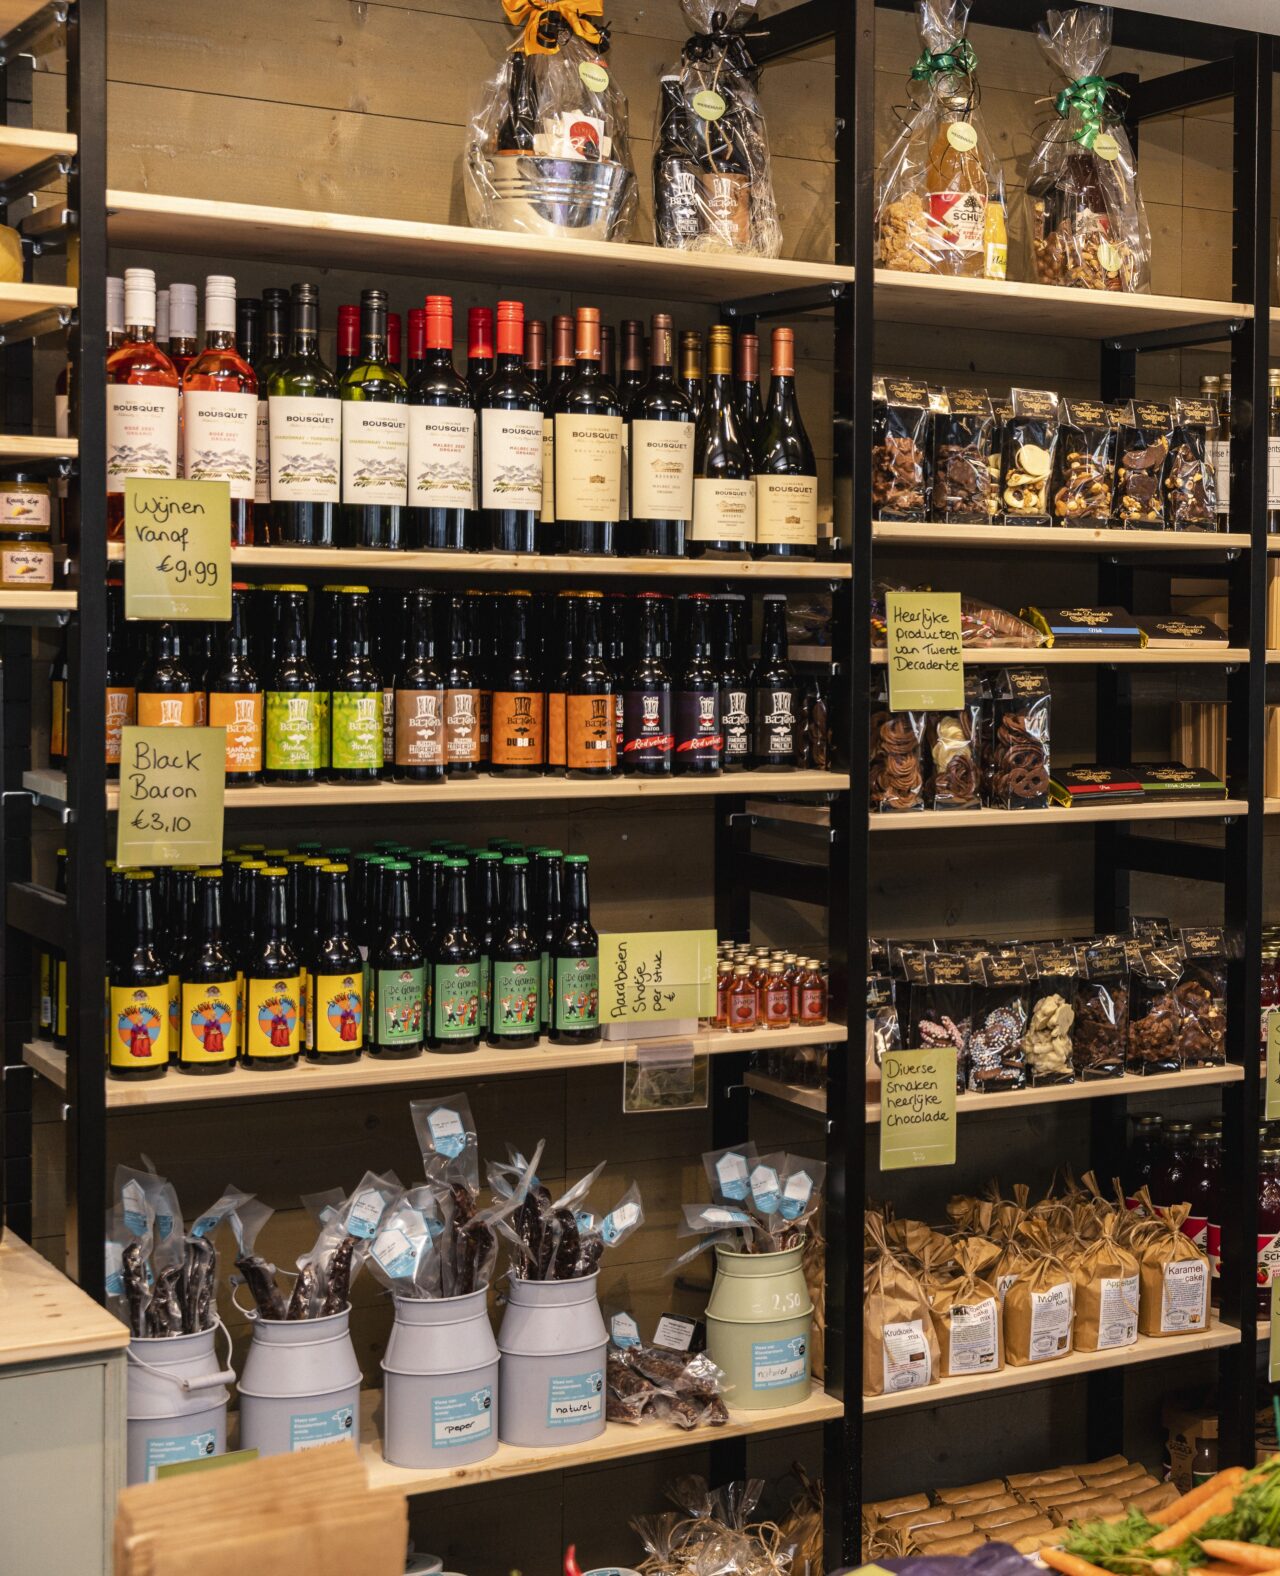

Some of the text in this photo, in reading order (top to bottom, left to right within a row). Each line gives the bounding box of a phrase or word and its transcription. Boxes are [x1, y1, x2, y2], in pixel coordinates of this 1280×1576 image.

[113, 405, 165, 413] BOUSQUET
[198, 411, 248, 419] BOUSQUET
[286, 415, 334, 424] BOUSQUET
[362, 420, 406, 428] BOUSQUET
[425, 424, 469, 433] BOUSQUET
[502, 428, 542, 436] BOUSQUET
[572, 431, 618, 439] BOUSQUET
[894, 606, 949, 629] Heerlijke
[896, 628, 959, 643] producten
[896, 646, 919, 654] van
[894, 656, 959, 671] Decadente
[765, 715, 796, 724] Baron
[507, 738, 535, 746] DUBBEL
[585, 740, 612, 749] DUBBEL
[634, 736, 668, 749] Red velvet
[691, 736, 721, 748] Red velvet
[132, 741, 201, 772] Black
[129, 773, 197, 800] Baron
[131, 809, 191, 833] €3,10
[611, 942, 628, 1018] Aardbeien
[653, 950, 666, 1012] per stuk
[632, 962, 652, 1013] Shotje
[885, 1059, 936, 1078] Diverse
[887, 1080, 938, 1092] smaken
[887, 1097, 942, 1112] heerlijke
[886, 1112, 949, 1126] Chocolade
[1168, 1266, 1202, 1275] Karamel
[1106, 1279, 1137, 1287] Appeltaar
[1038, 1291, 1063, 1303] Molen
[555, 1404, 591, 1414] naturel
